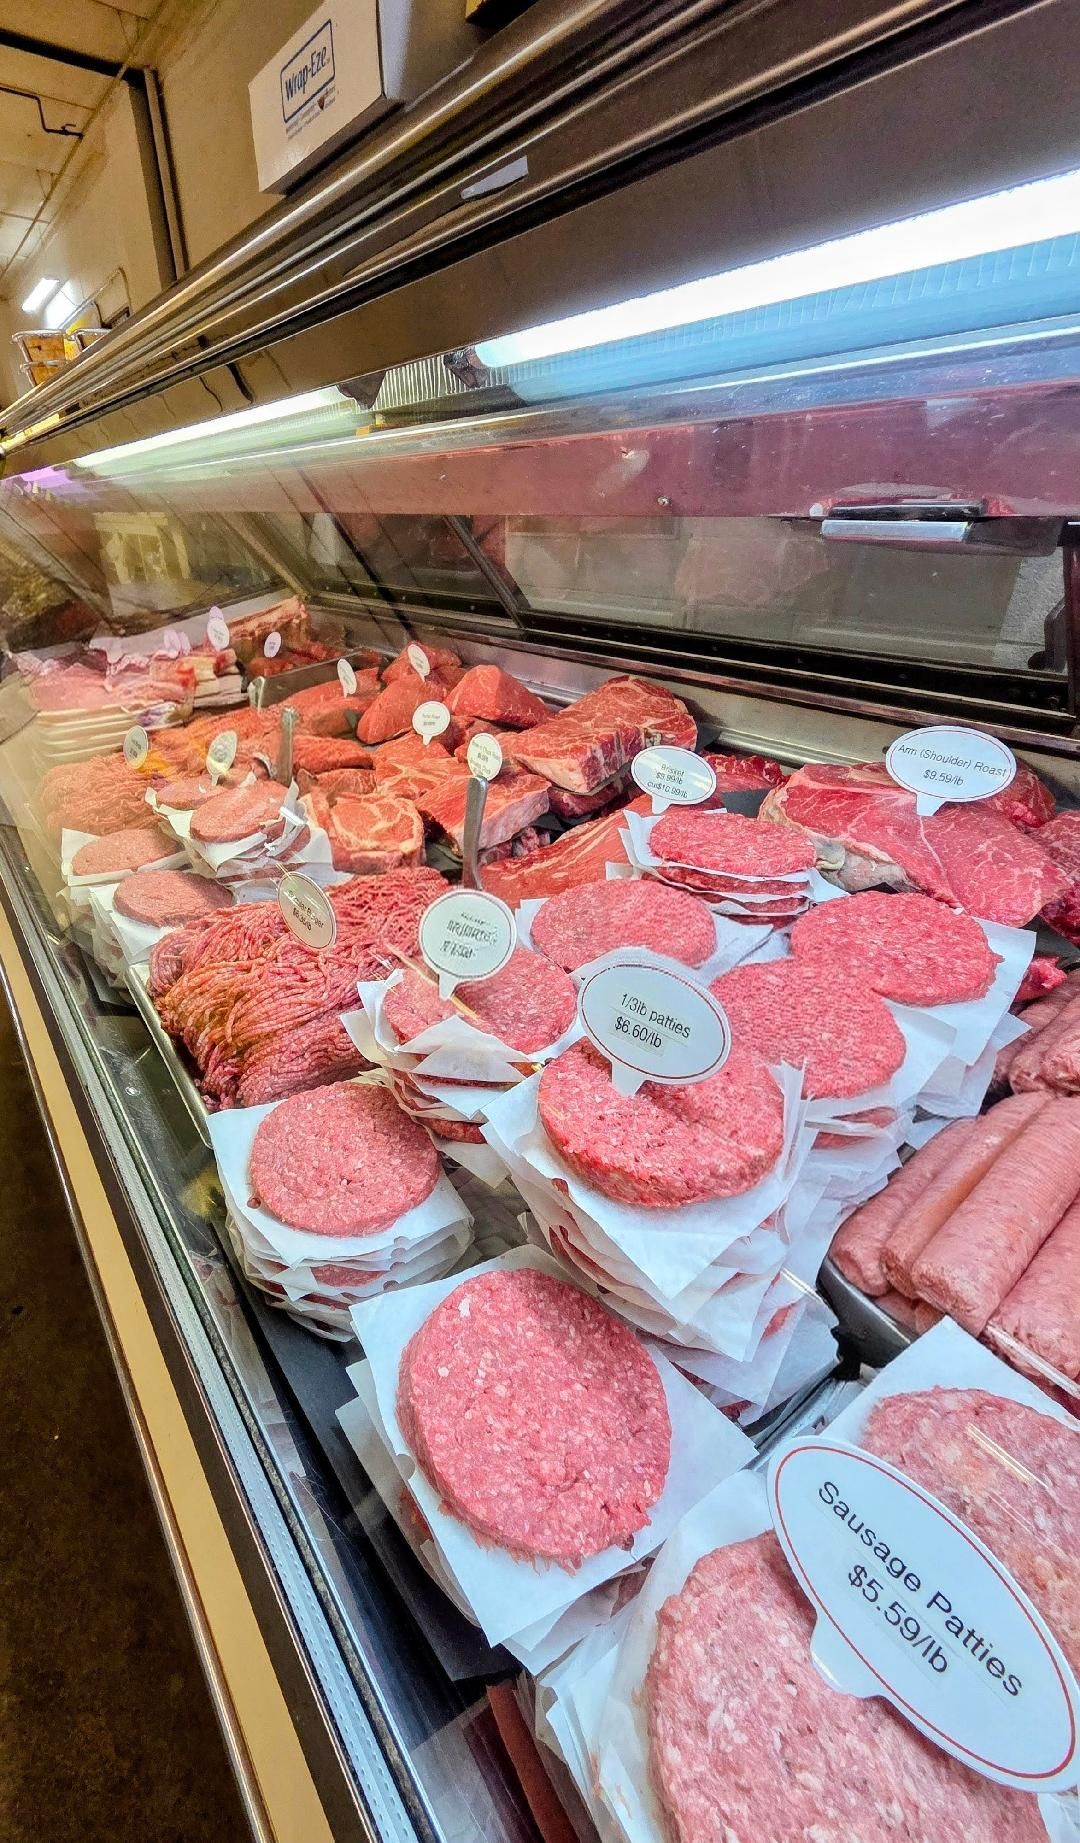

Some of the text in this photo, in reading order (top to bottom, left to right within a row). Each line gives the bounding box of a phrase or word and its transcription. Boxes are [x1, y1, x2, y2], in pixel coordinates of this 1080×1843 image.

[285, 46, 327, 101] Wrap-Eze
[898, 744, 1007, 777] Arm (Shoulder) Roast
[923, 769, 964, 786] $9.59/lb
[614, 1016, 662, 1048] $6.60/lb
[621, 993, 691, 1039] 1/3lb patties
[818, 1481, 1022, 1696] Sausage Patties
[848, 1564, 948, 1673] $5.59/lb
